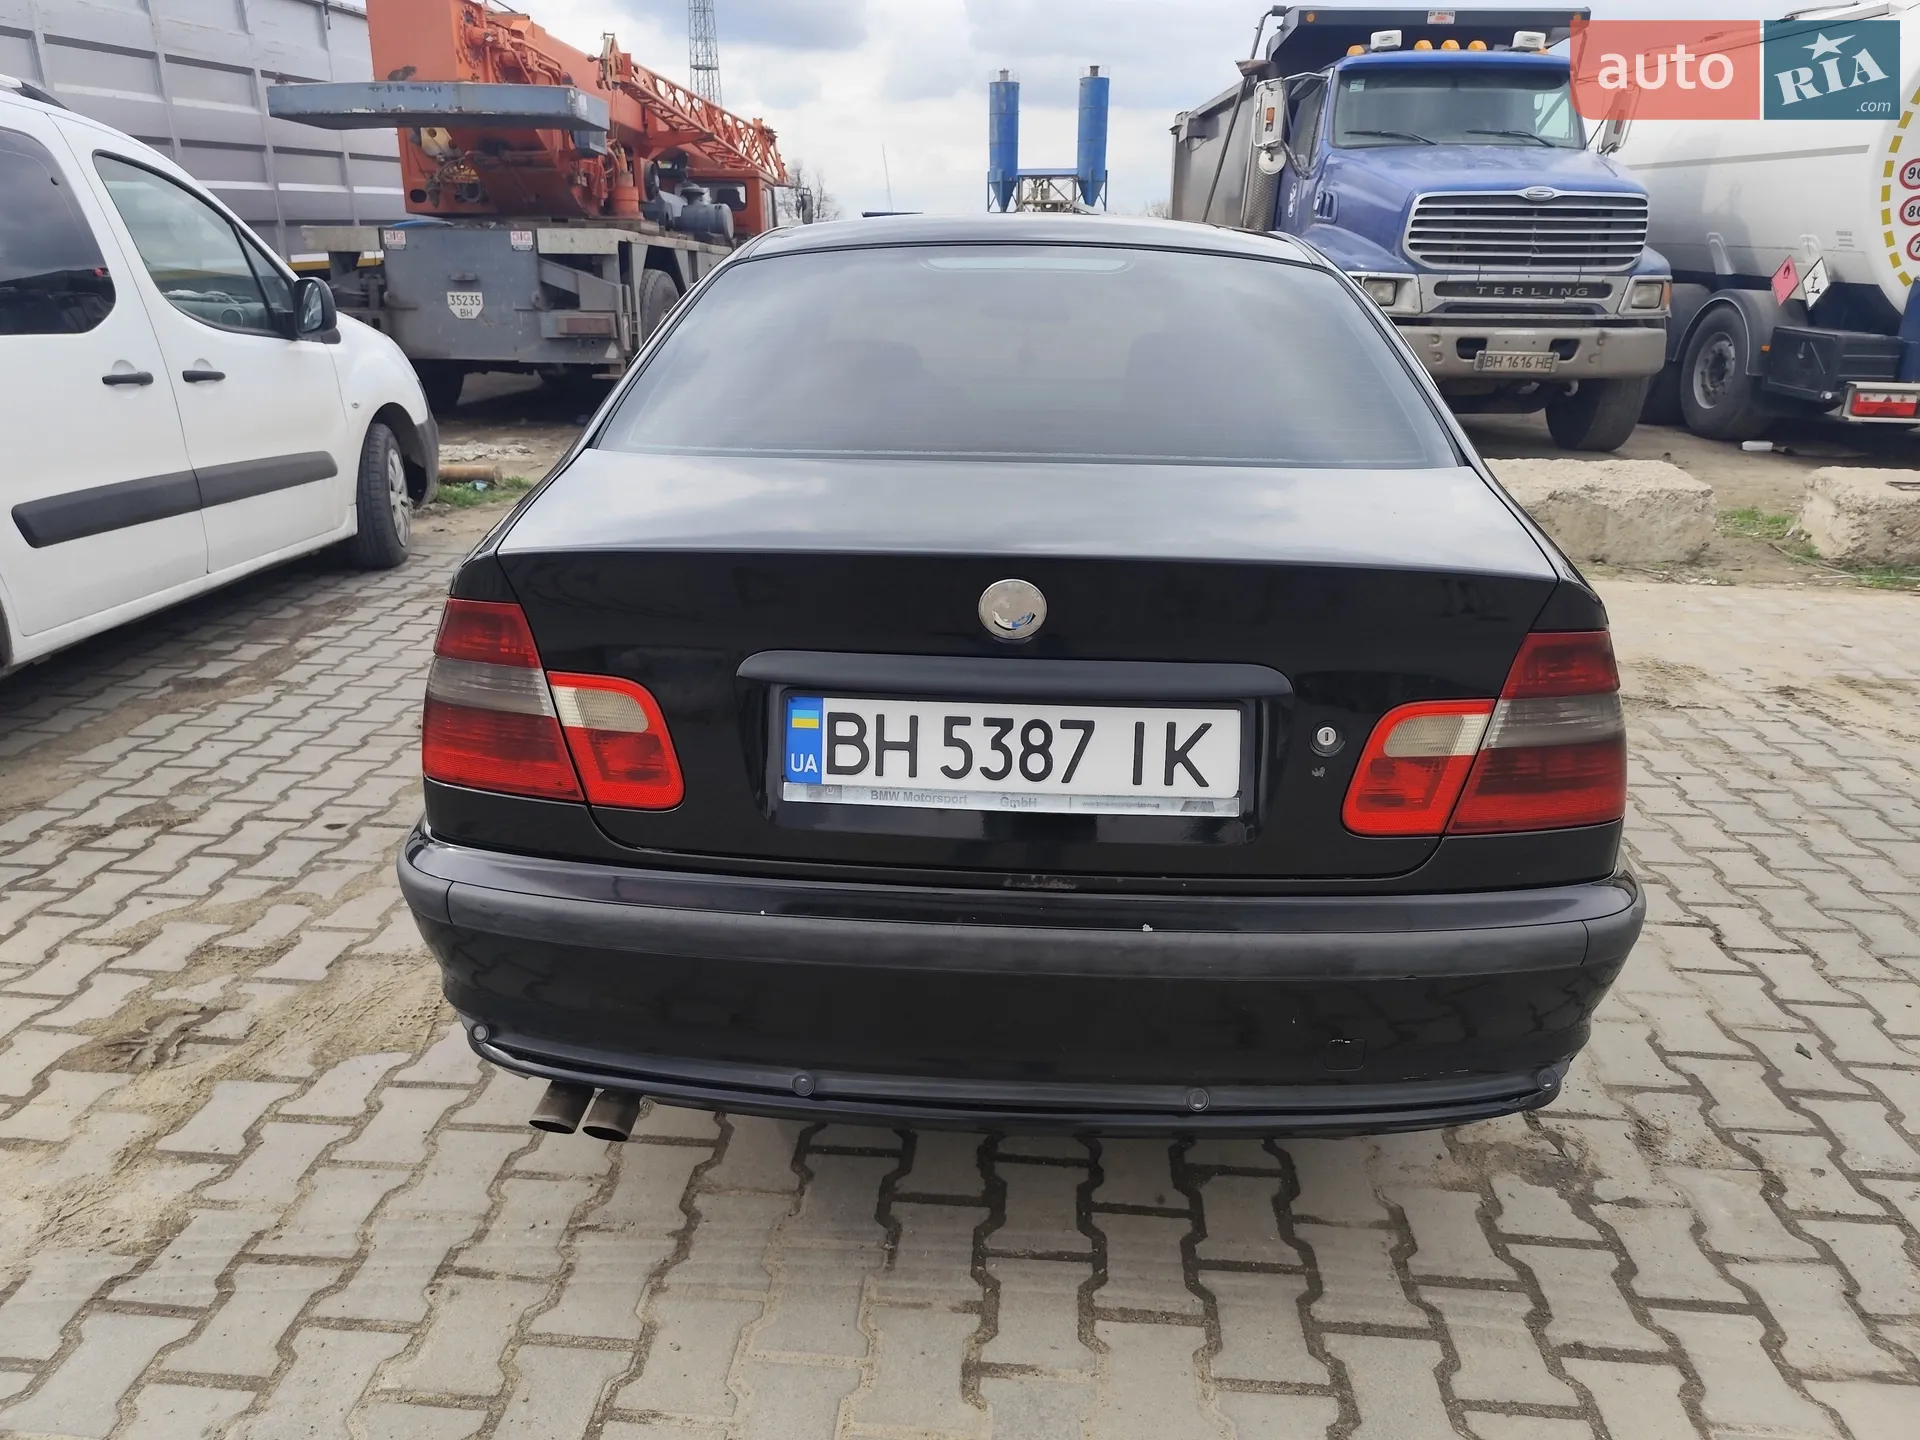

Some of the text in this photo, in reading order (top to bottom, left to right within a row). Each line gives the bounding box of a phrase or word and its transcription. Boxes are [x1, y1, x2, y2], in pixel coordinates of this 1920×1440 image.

[1476, 286, 1589, 297] TERLING
[450, 295, 481, 306] 35235
[459, 308, 473, 317] BH
[1484, 355, 1502, 368] BH
[1506, 355, 1533, 369] 1616
[826, 711, 1213, 788] BH 5387 IK
[790, 753, 818, 774] UA
[870, 790, 900, 801] BMW
[903, 791, 968, 805] Motorsport
[1000, 796, 1037, 808] GmbH
